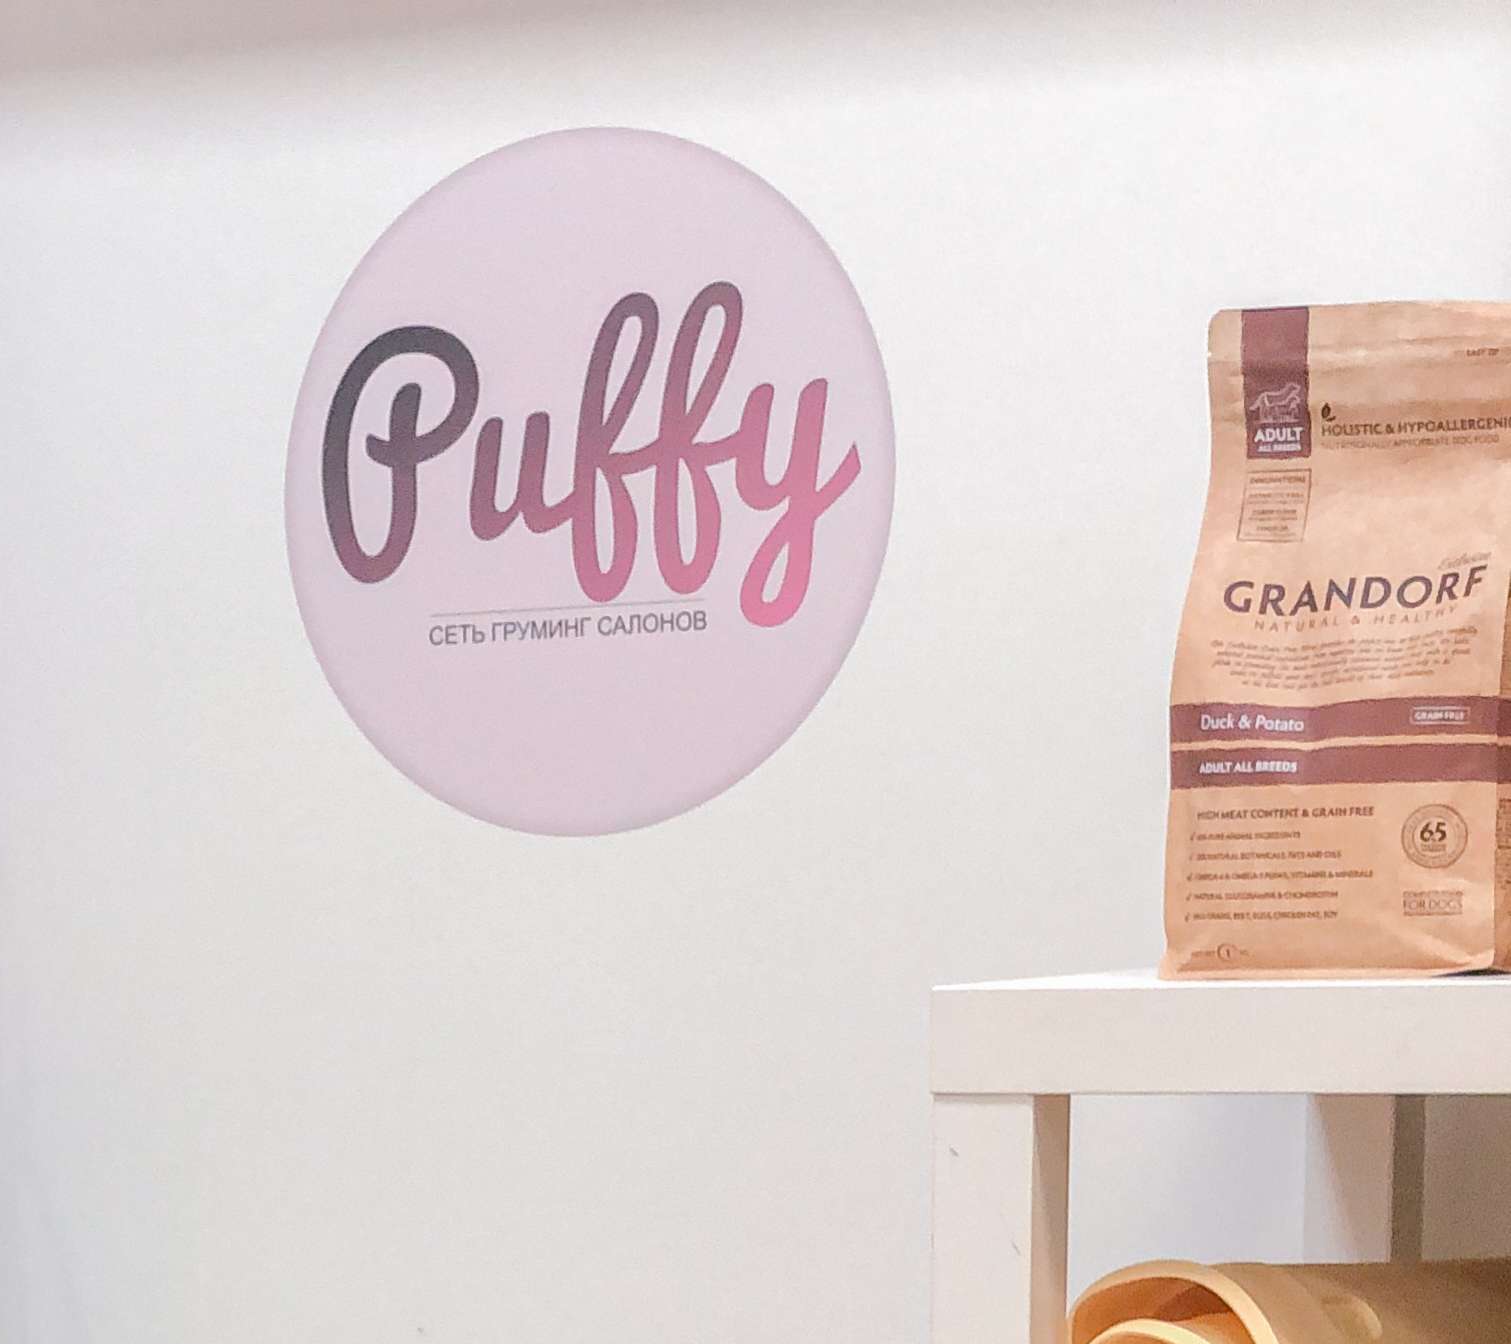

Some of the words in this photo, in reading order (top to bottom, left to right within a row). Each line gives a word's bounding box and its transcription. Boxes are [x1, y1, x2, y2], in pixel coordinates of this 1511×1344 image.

[1254, 427, 1304, 442] ADULT
[1321, 423, 1384, 437] HOLISTIC
[322, 281, 861, 627] Puffy
[1223, 564, 1489, 617] GRANDORF
[428, 624, 485, 646] СЕТЬ
[491, 617, 592, 642] ГРУМИНГ
[597, 610, 708, 637] САЛОНОВ
[1254, 617, 1340, 633] NATURAL
[1373, 604, 1458, 626] HEALTHY
[1200, 714, 1234, 730] Duck
[1238, 715, 1251, 729] &
[1255, 716, 1304, 732] Potato
[1199, 762, 1232, 774] ADULT
[1233, 760, 1254, 773] ALL
[1255, 761, 1298, 773] BREEDS
[1221, 810, 1249, 819] MEAT
[1251, 808, 1299, 819] CONTENT
[1302, 808, 1310, 818] &
[1312, 807, 1348, 818] GRAIN
[1349, 806, 1375, 817] FREE
[1420, 821, 1447, 842] 65
